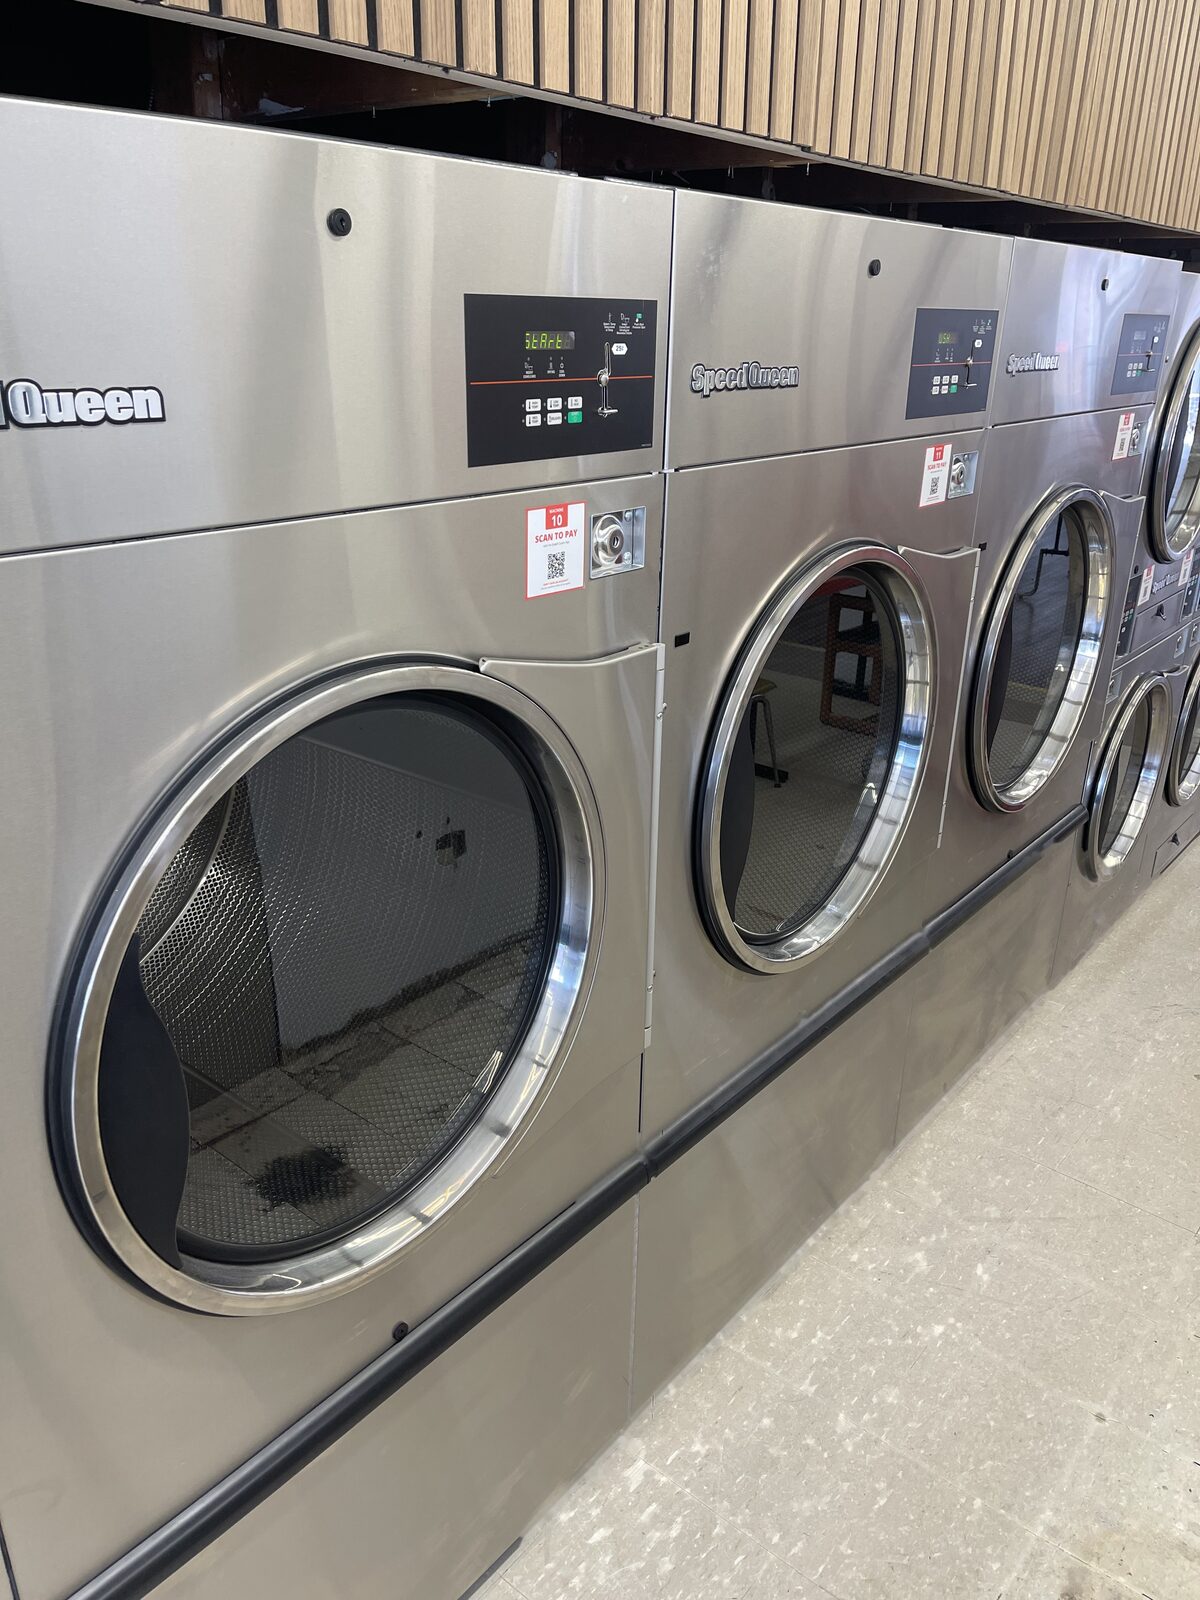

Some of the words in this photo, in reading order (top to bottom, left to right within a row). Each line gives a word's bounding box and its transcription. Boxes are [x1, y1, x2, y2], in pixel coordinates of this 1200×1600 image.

[1006, 352, 1035, 377] Speed
[691, 362, 749, 398] Speed
[748, 361, 800, 389] Queen
[5, 378, 166, 428] Queen
[551, 514, 563, 527] 10
[535, 532, 553, 544] SCAN
[554, 531, 564, 540] TO
[565, 529, 578, 539] PAY
